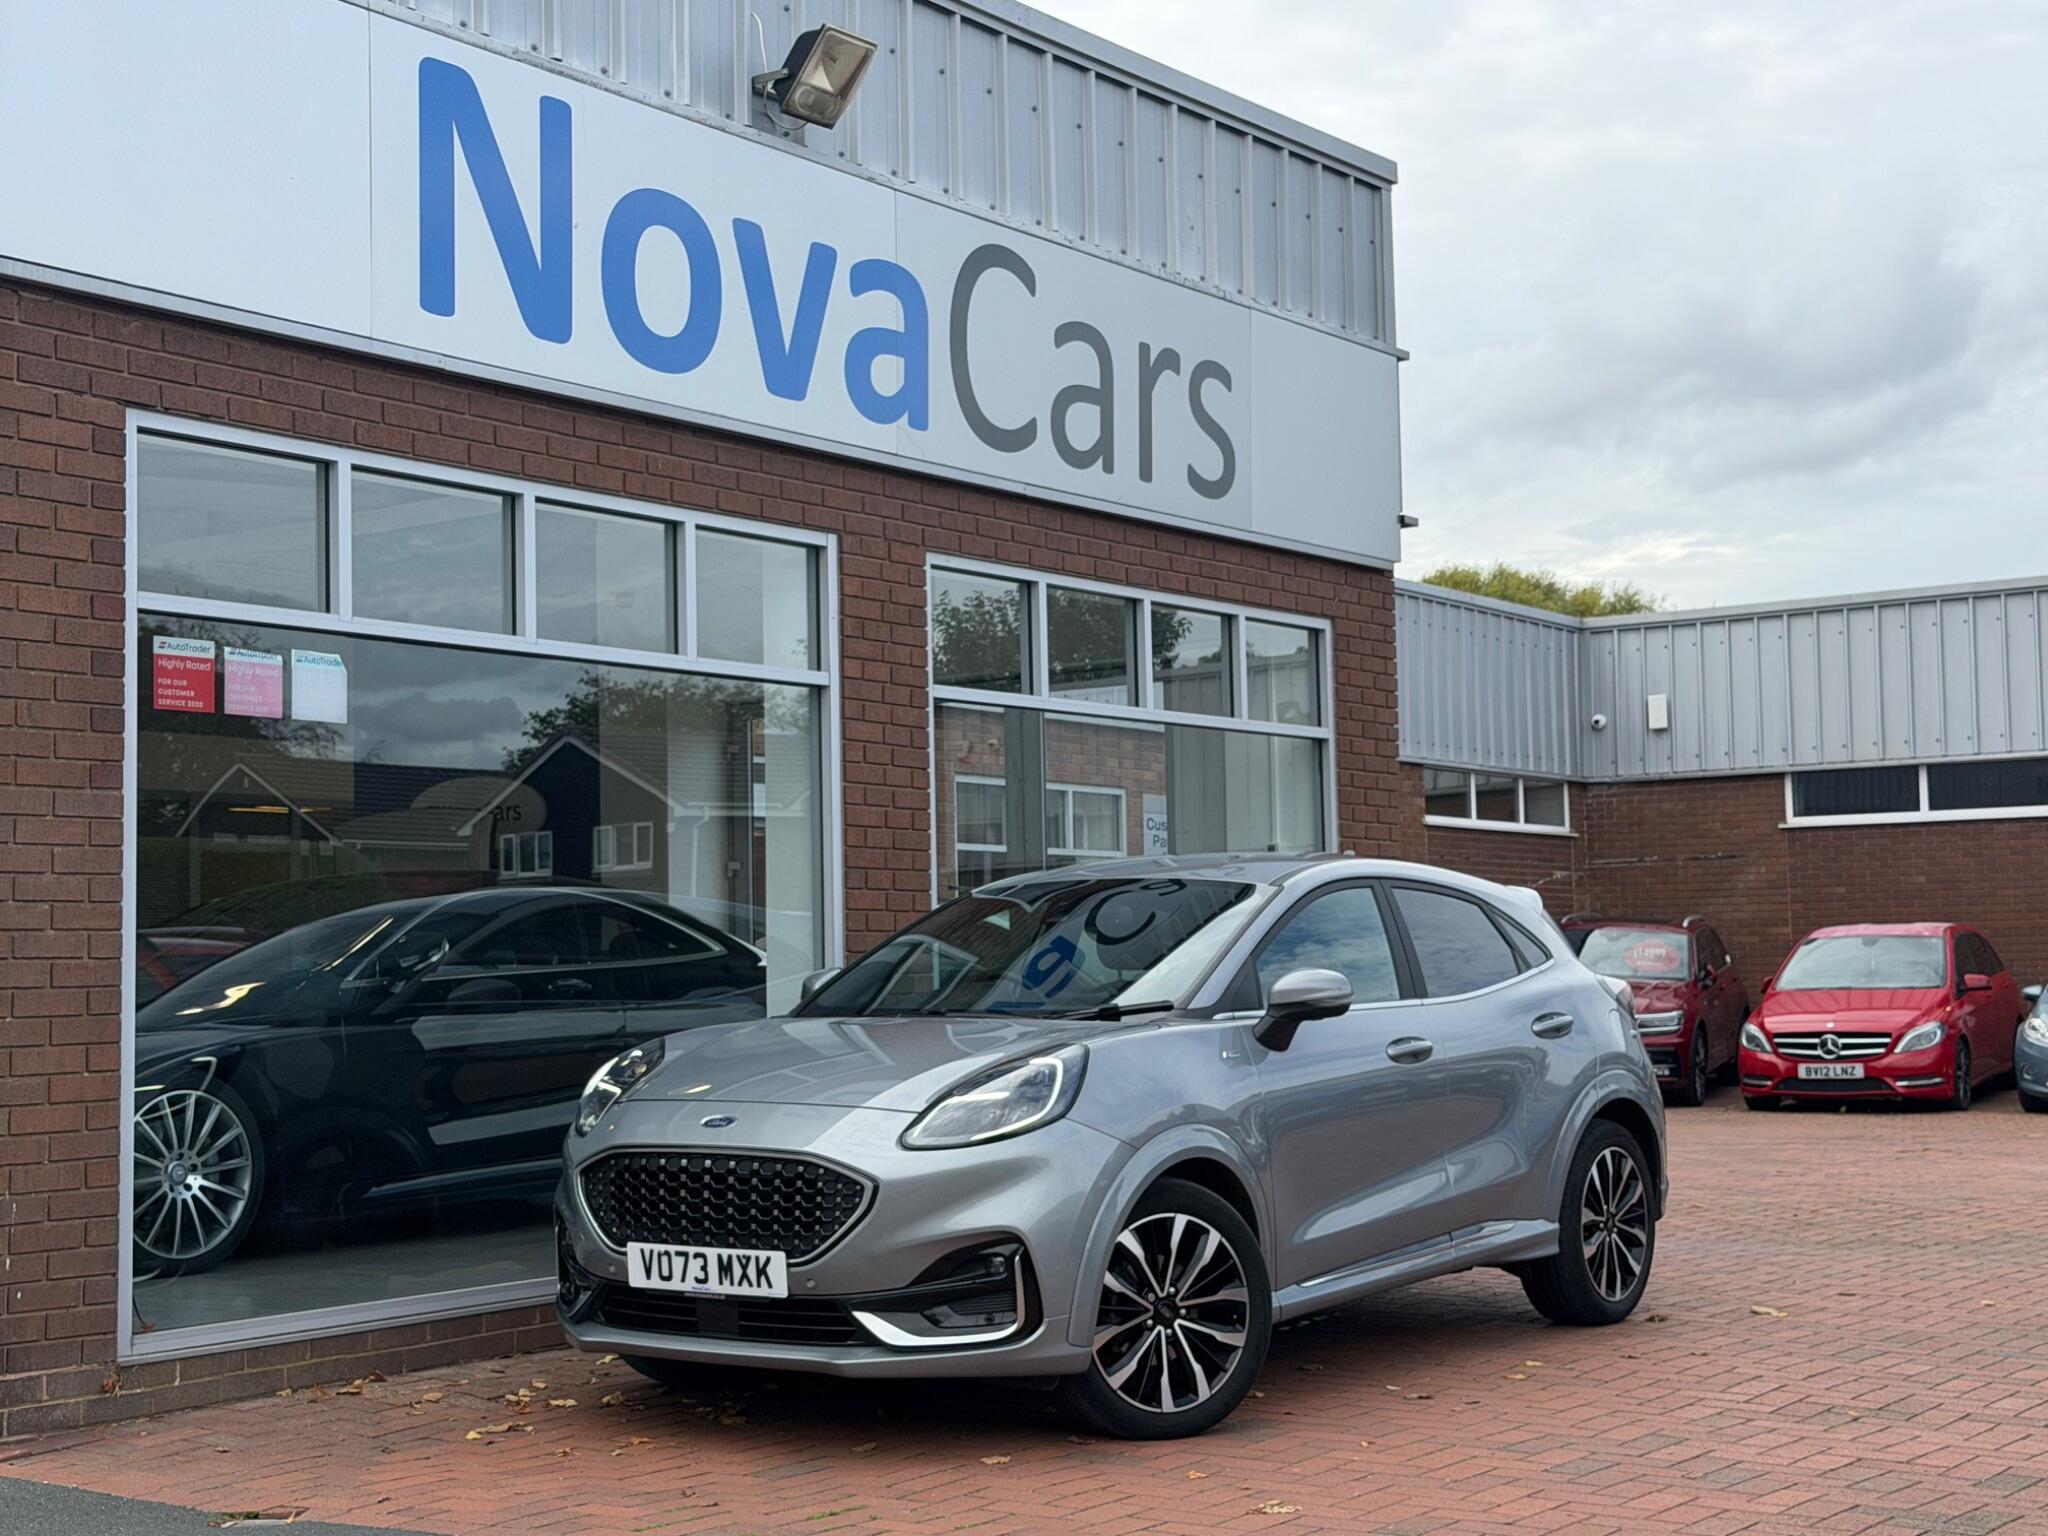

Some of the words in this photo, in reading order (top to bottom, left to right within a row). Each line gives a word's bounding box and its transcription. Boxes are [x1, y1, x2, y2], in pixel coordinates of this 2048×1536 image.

[419, 56, 1235, 500] NovaCars
[167, 642, 212, 654] AutoTrader
[158, 658, 185, 671] Highly
[186, 660, 211, 671] Rated
[173, 678, 187, 686] OUR
[158, 688, 195, 697] CUSTOMER
[158, 698, 186, 707] SERVICE
[1805, 1066, 1830, 1077] BV12
[1833, 1066, 1856, 1076] LNZ
[640, 1248, 709, 1285] VO73
[717, 1253, 773, 1289] MXK
